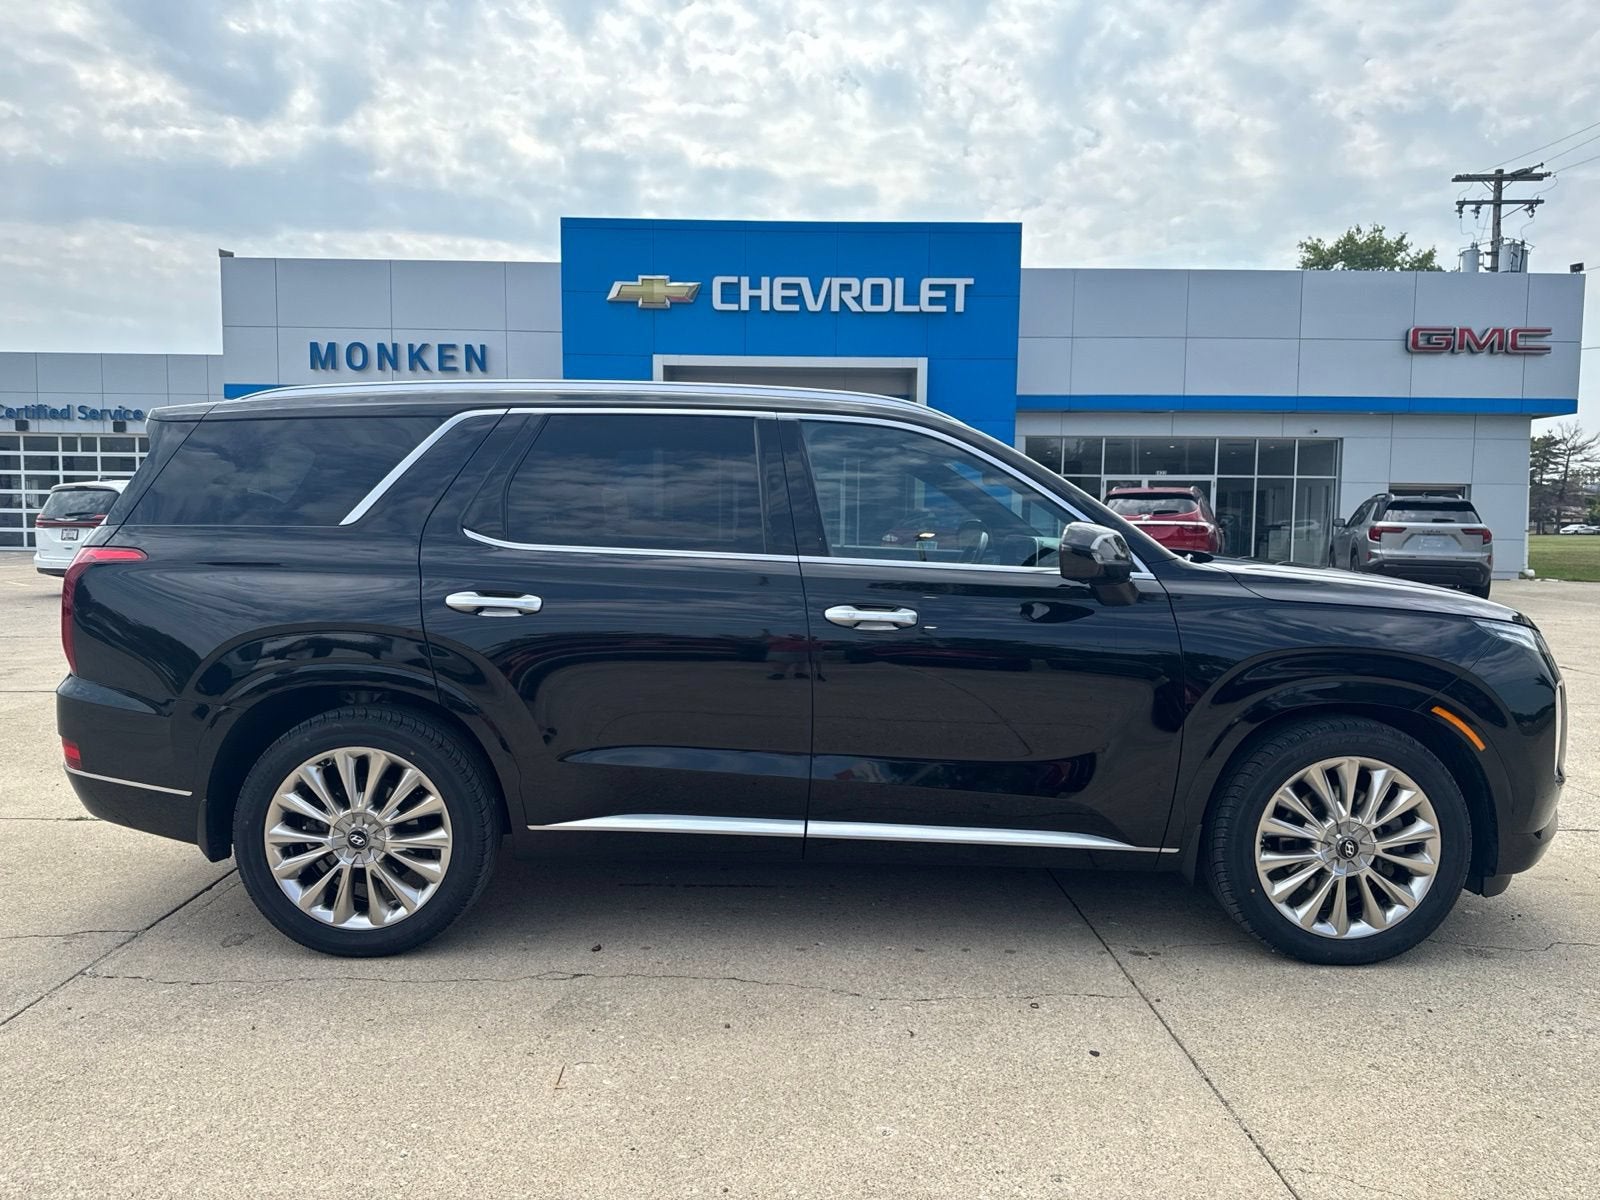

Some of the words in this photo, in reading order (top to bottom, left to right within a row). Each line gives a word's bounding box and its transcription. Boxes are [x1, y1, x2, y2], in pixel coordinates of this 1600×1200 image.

[712, 275, 975, 312] CHEVROLET
[1407, 327, 1552, 354] GMC
[310, 342, 487, 372] MONKEN
[78, 405, 144, 421] Service
